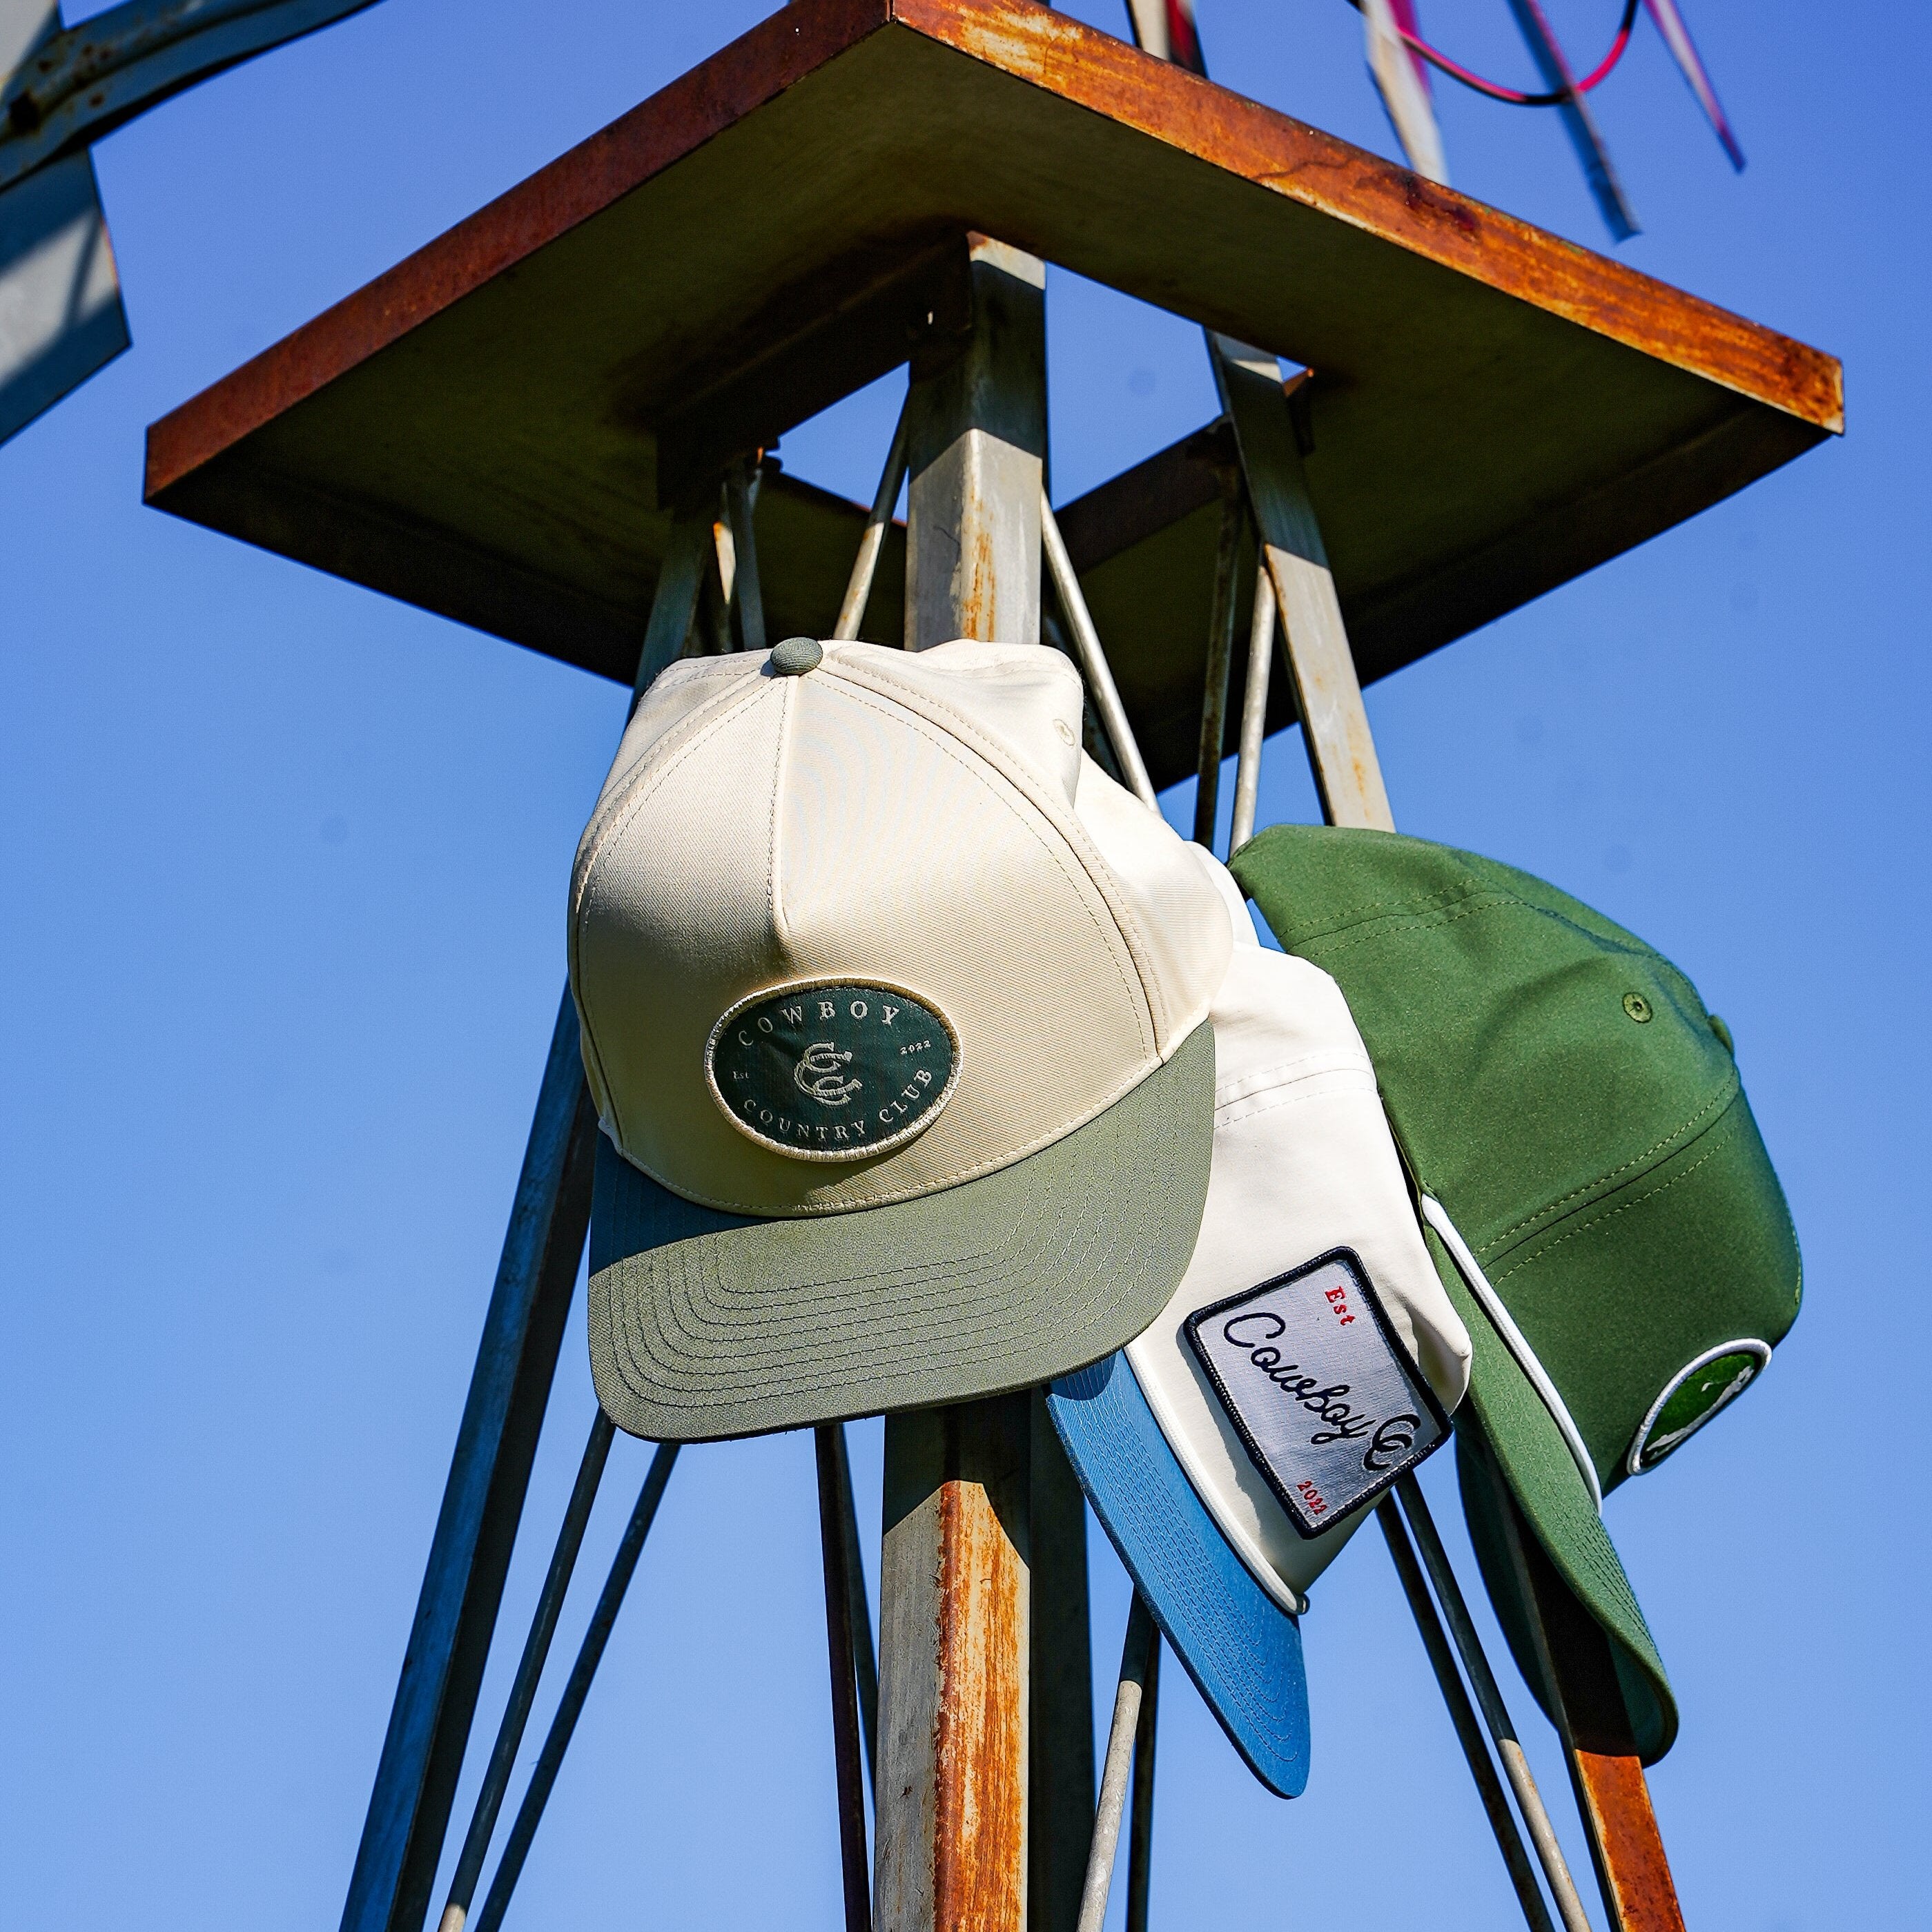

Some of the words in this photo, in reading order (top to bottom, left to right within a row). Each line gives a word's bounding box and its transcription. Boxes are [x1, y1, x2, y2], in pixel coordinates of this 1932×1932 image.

[738, 1000, 899, 1047] COWBOY
[900, 1040, 931, 1055] 2022
[732, 1071, 750, 1080] Est
[743, 1098, 866, 1141] COUNTRY
[879, 1069, 933, 1124] CLUB
[1325, 1286, 1356, 1326] Est
[1224, 1311, 1378, 1445] Cowboy
[1296, 1481, 1327, 1515] 2022
